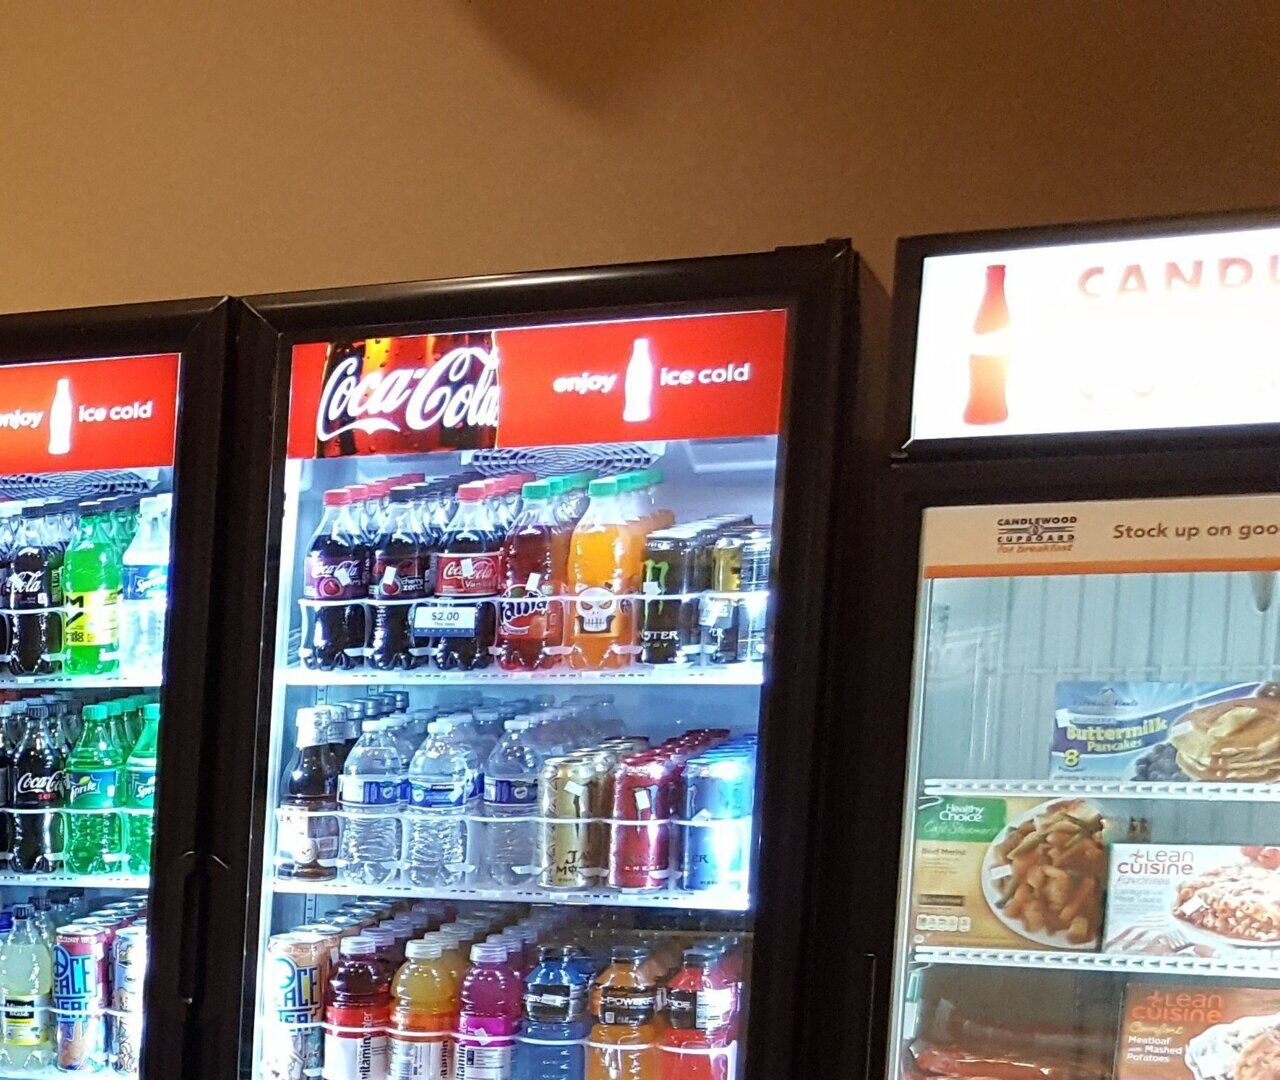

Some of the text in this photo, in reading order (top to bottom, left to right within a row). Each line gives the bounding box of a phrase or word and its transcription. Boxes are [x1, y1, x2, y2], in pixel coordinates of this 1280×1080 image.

[553, 363, 750, 394] enjoy ice cold
[317, 347, 501, 441] Coca-Cola
[78, 404, 107, 423] ice
[109, 400, 153, 421] cold
[997, 515, 1078, 526] CANDLEWOOD
[997, 534, 1076, 543] CUPBOARD
[1112, 523, 1168, 539] Stock
[1175, 525, 1200, 542] up
[1206, 525, 1232, 538] on
[431, 612, 460, 622] $2.00
[1066, 716, 1168, 740] Buttermilk
[1087, 739, 1142, 752] Pancakes
[1064, 748, 1080, 767] 8
[69, 778, 103, 797] Sprite
[945, 803, 986, 814] Healthy
[939, 810, 983, 823] Choice
[1145, 849, 1195, 863] Lean
[1164, 992, 1222, 1008] Lean
[1127, 1035, 1172, 1046] Meatloaf
[1144, 1045, 1183, 1056] Mashed
[1127, 1053, 1170, 1063] Potatoes
